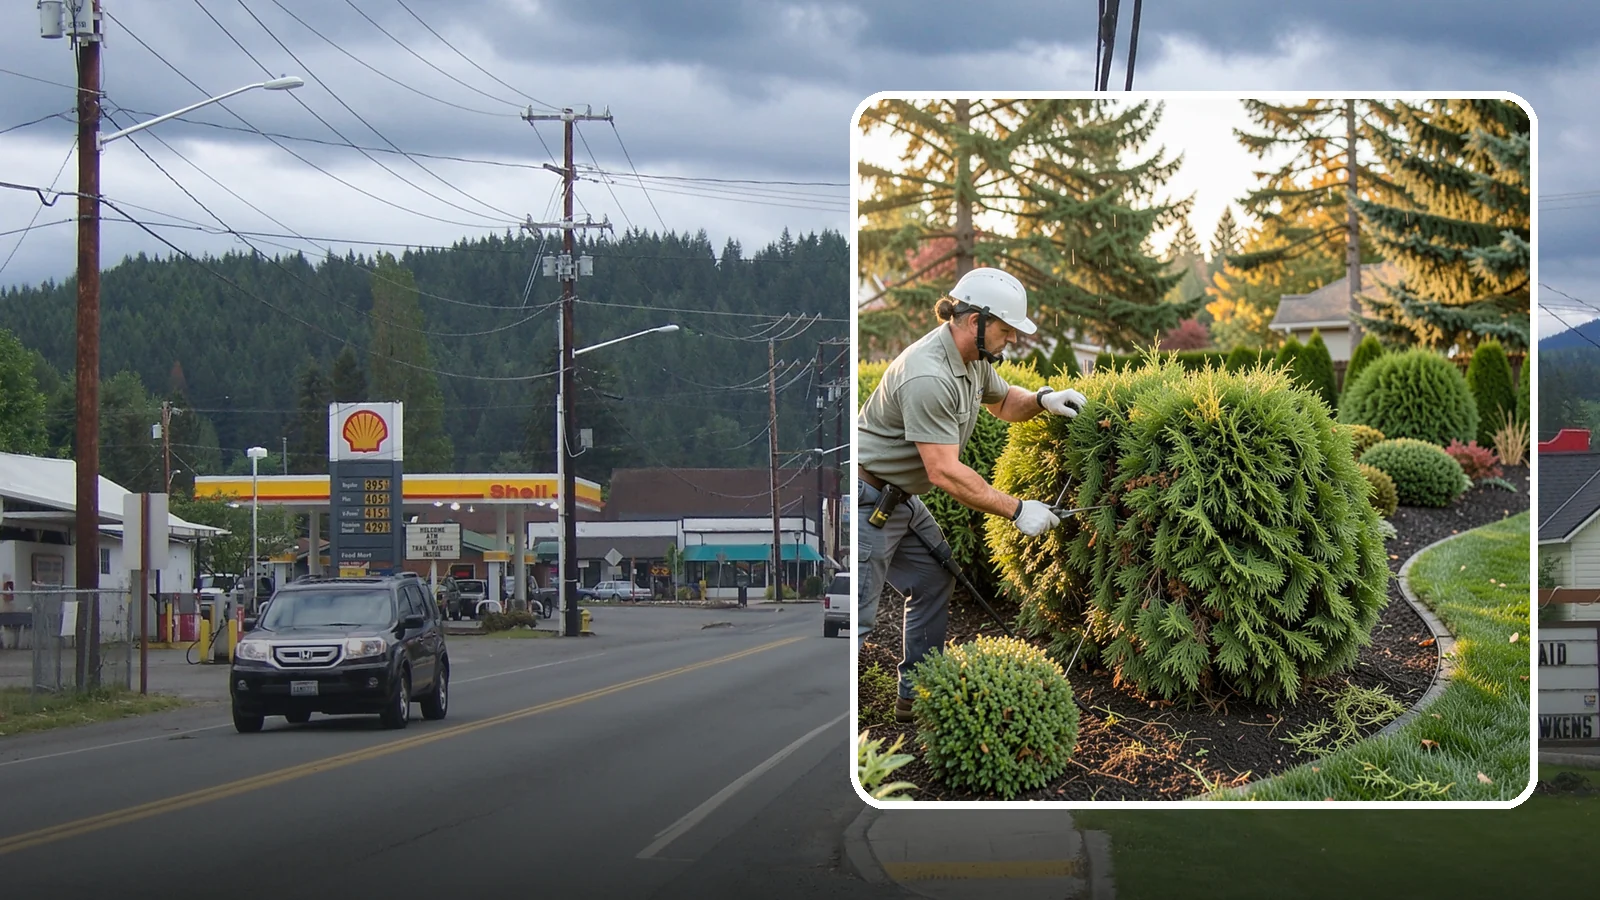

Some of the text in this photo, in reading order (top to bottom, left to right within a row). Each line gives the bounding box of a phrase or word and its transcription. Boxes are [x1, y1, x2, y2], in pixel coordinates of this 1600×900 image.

[365, 480, 383, 490] 395
[490, 484, 547, 499] Shell
[365, 494, 383, 504] 405
[365, 508, 383, 518] 415
[365, 522, 383, 532] 429
[1538, 643, 1567, 666] AID
